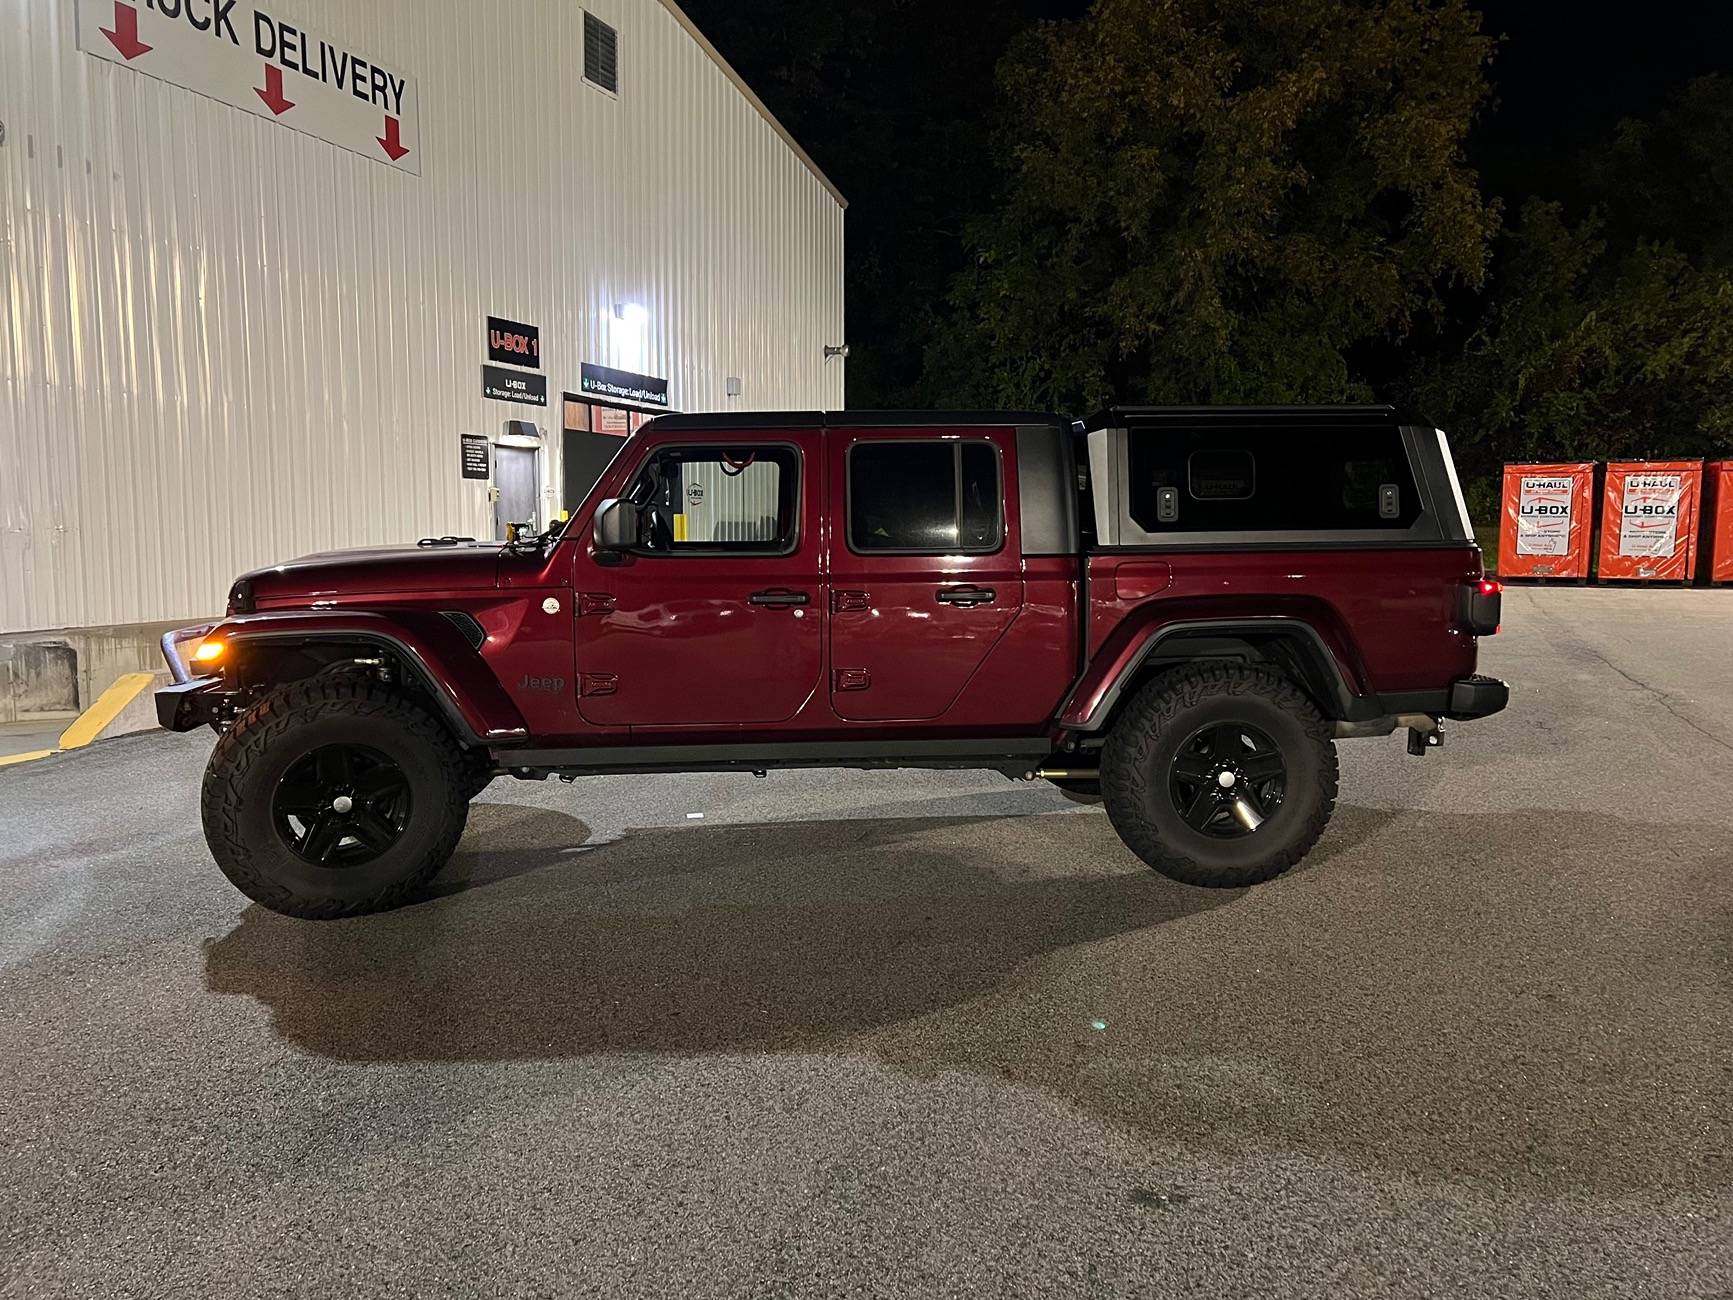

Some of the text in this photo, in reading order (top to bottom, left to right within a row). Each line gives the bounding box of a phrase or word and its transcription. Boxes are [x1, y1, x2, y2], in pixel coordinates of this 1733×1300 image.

[253, 10, 406, 117] DELIVERY
[490, 329, 538, 356] U-BOX 1
[504, 379, 527, 390] U-BOX
[1525, 481, 1568, 489] U-HAUL
[1521, 505, 1569, 515] U-BOX
[1624, 505, 1676, 515] U-BOX
[519, 674, 564, 692] Jeep
